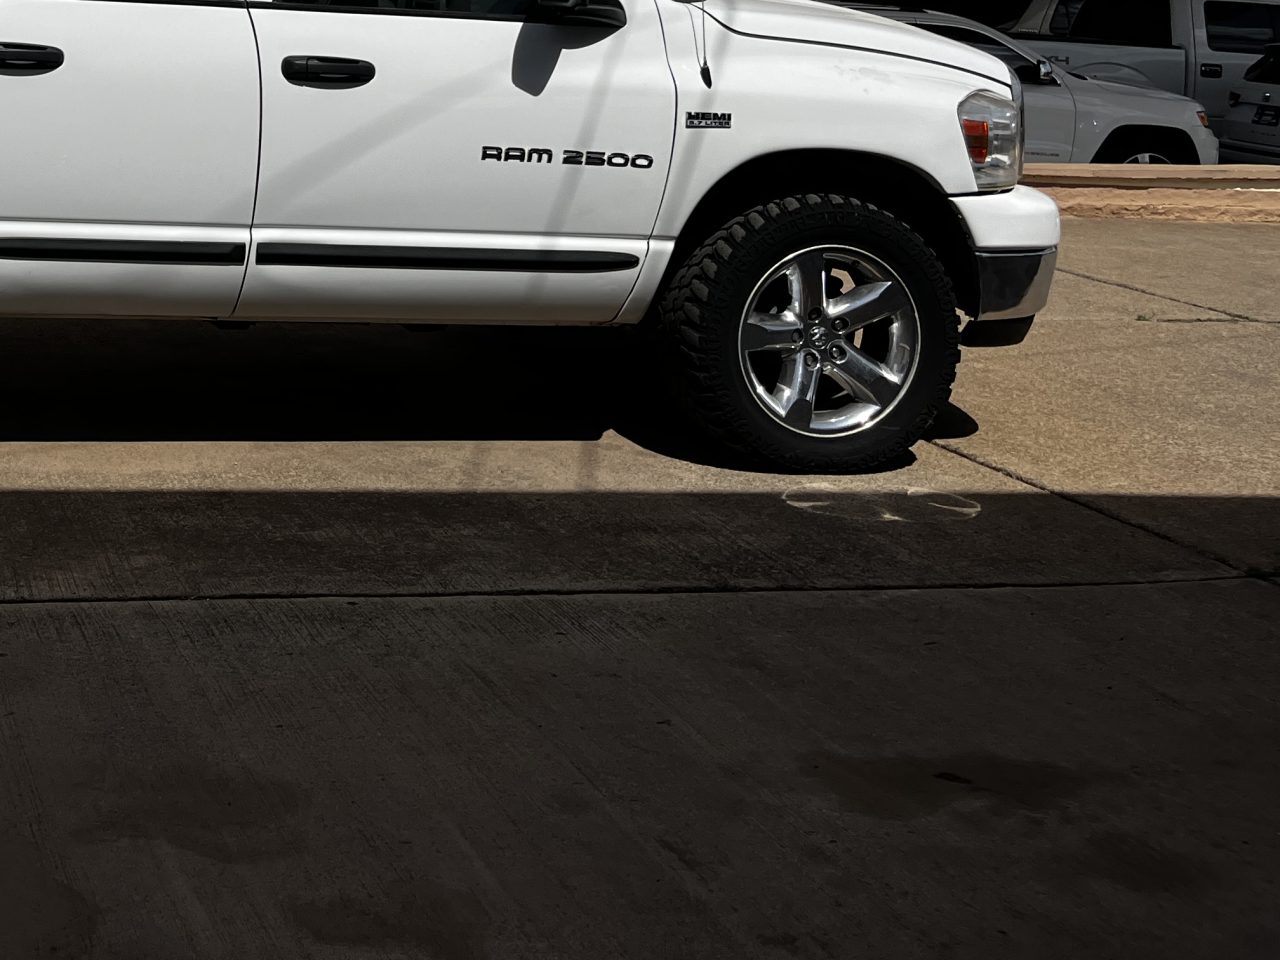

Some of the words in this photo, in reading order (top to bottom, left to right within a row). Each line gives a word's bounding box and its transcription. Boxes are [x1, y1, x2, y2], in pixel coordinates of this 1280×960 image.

[686, 112, 732, 121] HEMI
[481, 146, 553, 164] RAM
[562, 150, 654, 169] 2500
